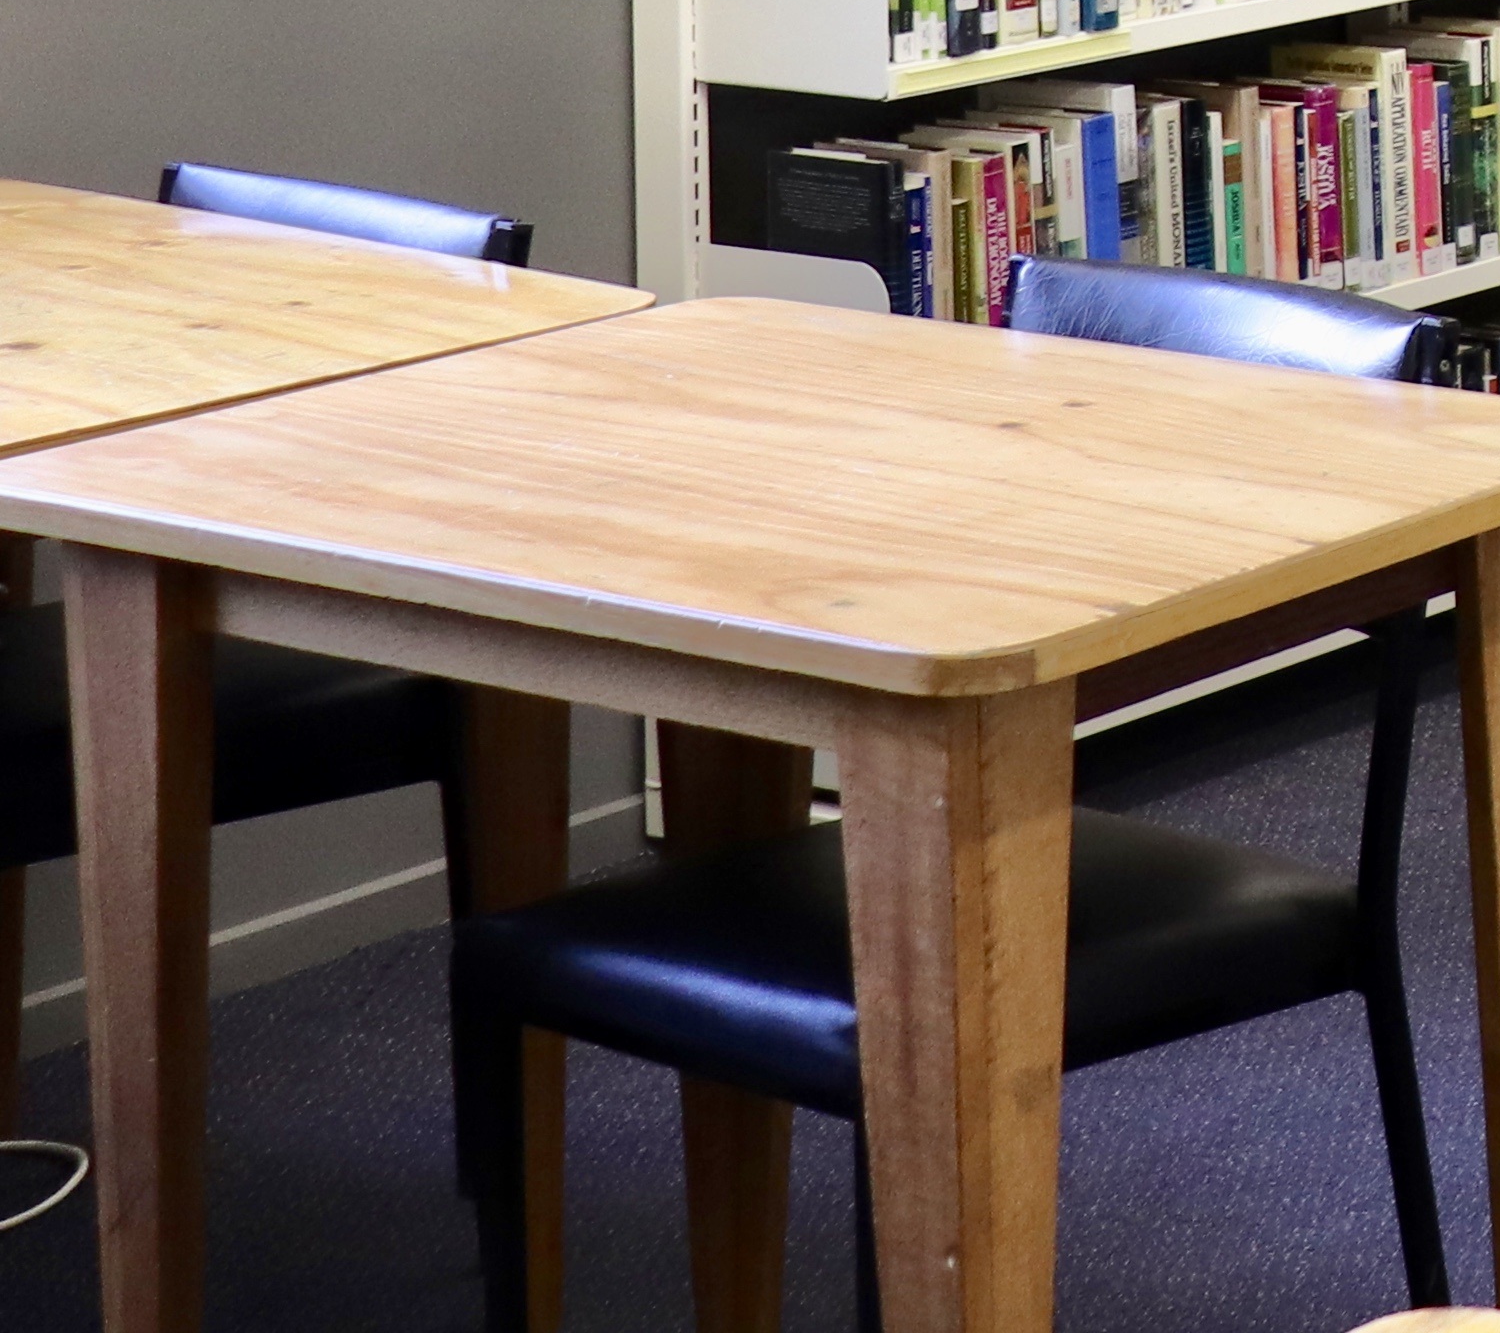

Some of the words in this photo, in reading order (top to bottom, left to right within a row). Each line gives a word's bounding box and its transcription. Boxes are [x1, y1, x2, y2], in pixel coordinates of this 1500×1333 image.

[1167, 119, 1178, 164] Israel's
[1169, 167, 1179, 209] United
[987, 197, 1002, 307] DEUTERONOMY
